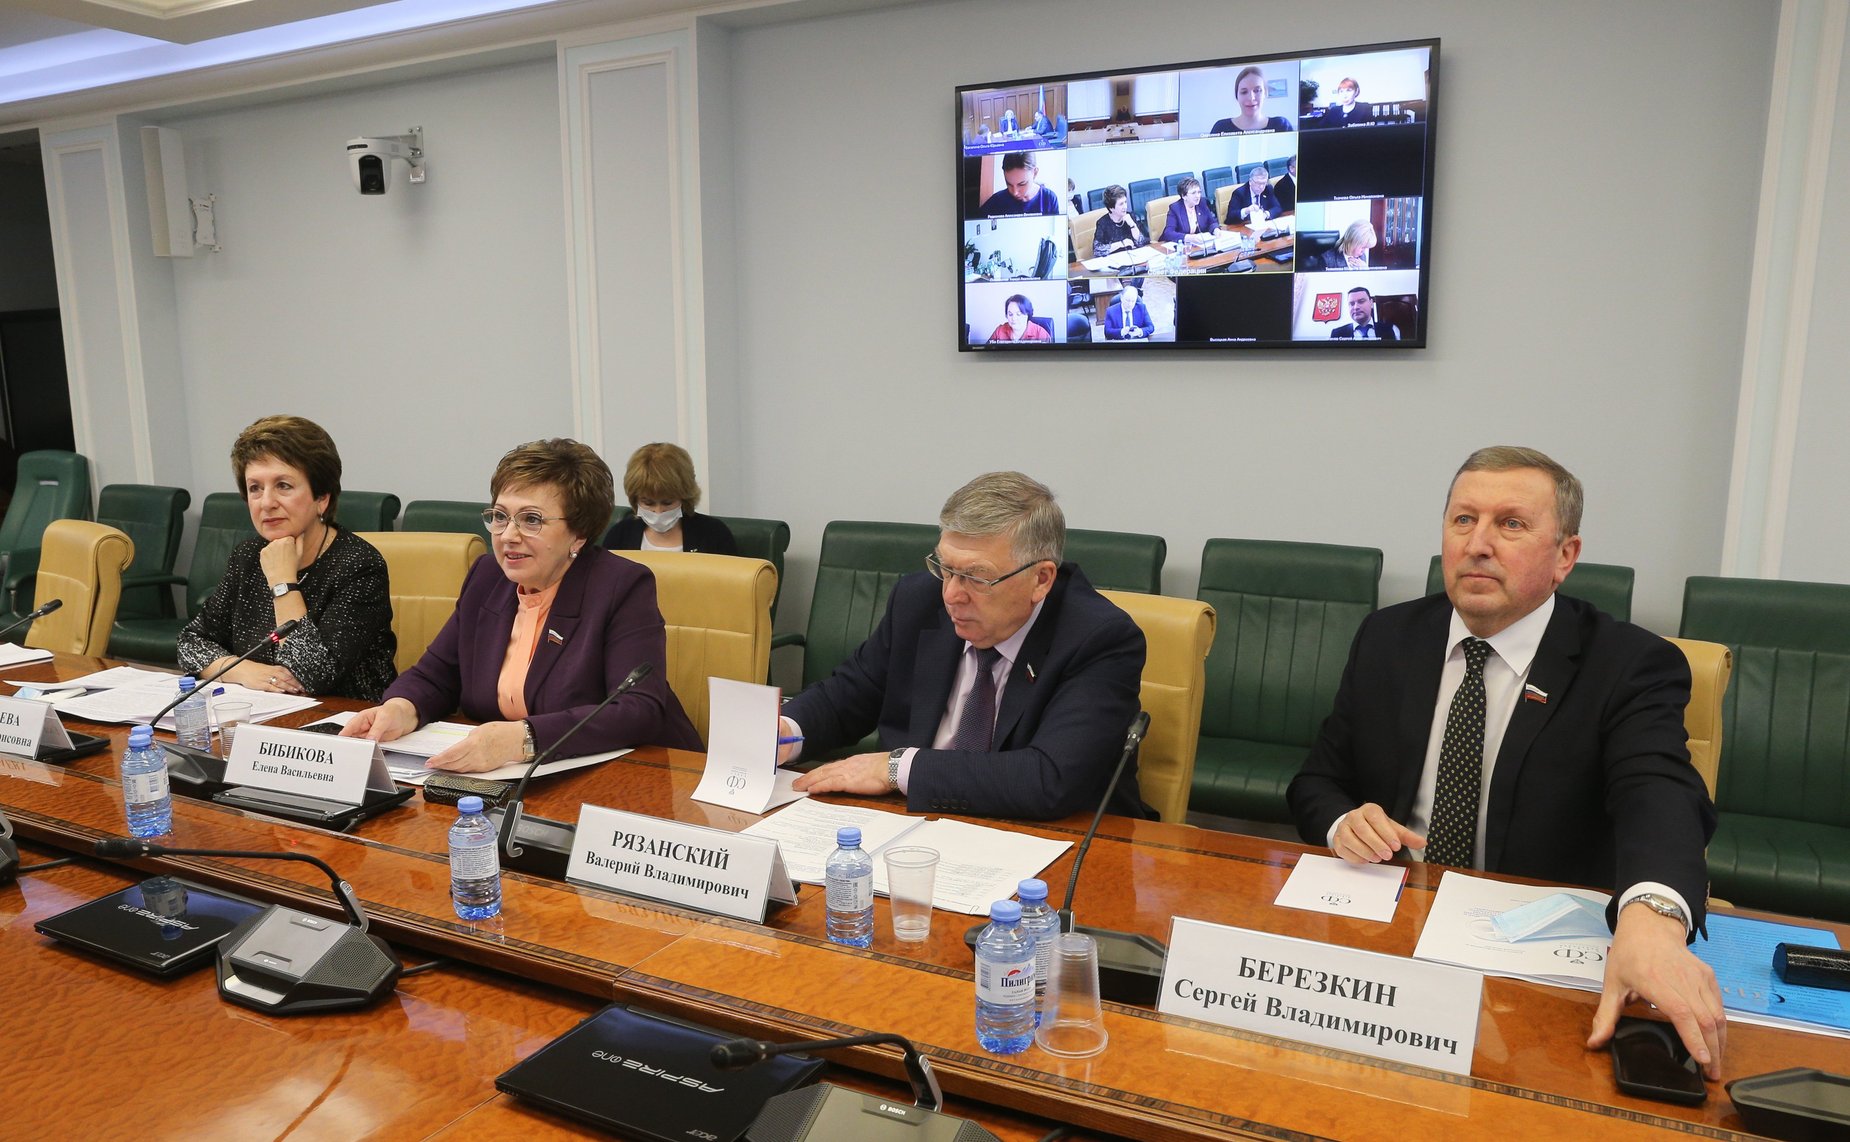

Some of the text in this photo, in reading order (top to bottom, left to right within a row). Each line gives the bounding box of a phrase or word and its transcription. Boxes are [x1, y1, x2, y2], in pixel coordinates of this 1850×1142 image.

[0, 731, 32, 748] исовна
[258, 741, 334, 765] БИБИКОВА
[252, 760, 334, 783] Елена Васильевна
[611, 830, 731, 871] РЯЗАНСКИЙ
[585, 850, 750, 900] Валерий Владимирович
[1237, 956, 1398, 1007] БЕРЕЗКИН
[1174, 978, 1458, 1055] Сергей Владимирович
[591, 1050, 725, 1093] ASPIRE one
[887, 1106, 907, 1116] BOSCH
[685, 1129, 718, 1141] acer
